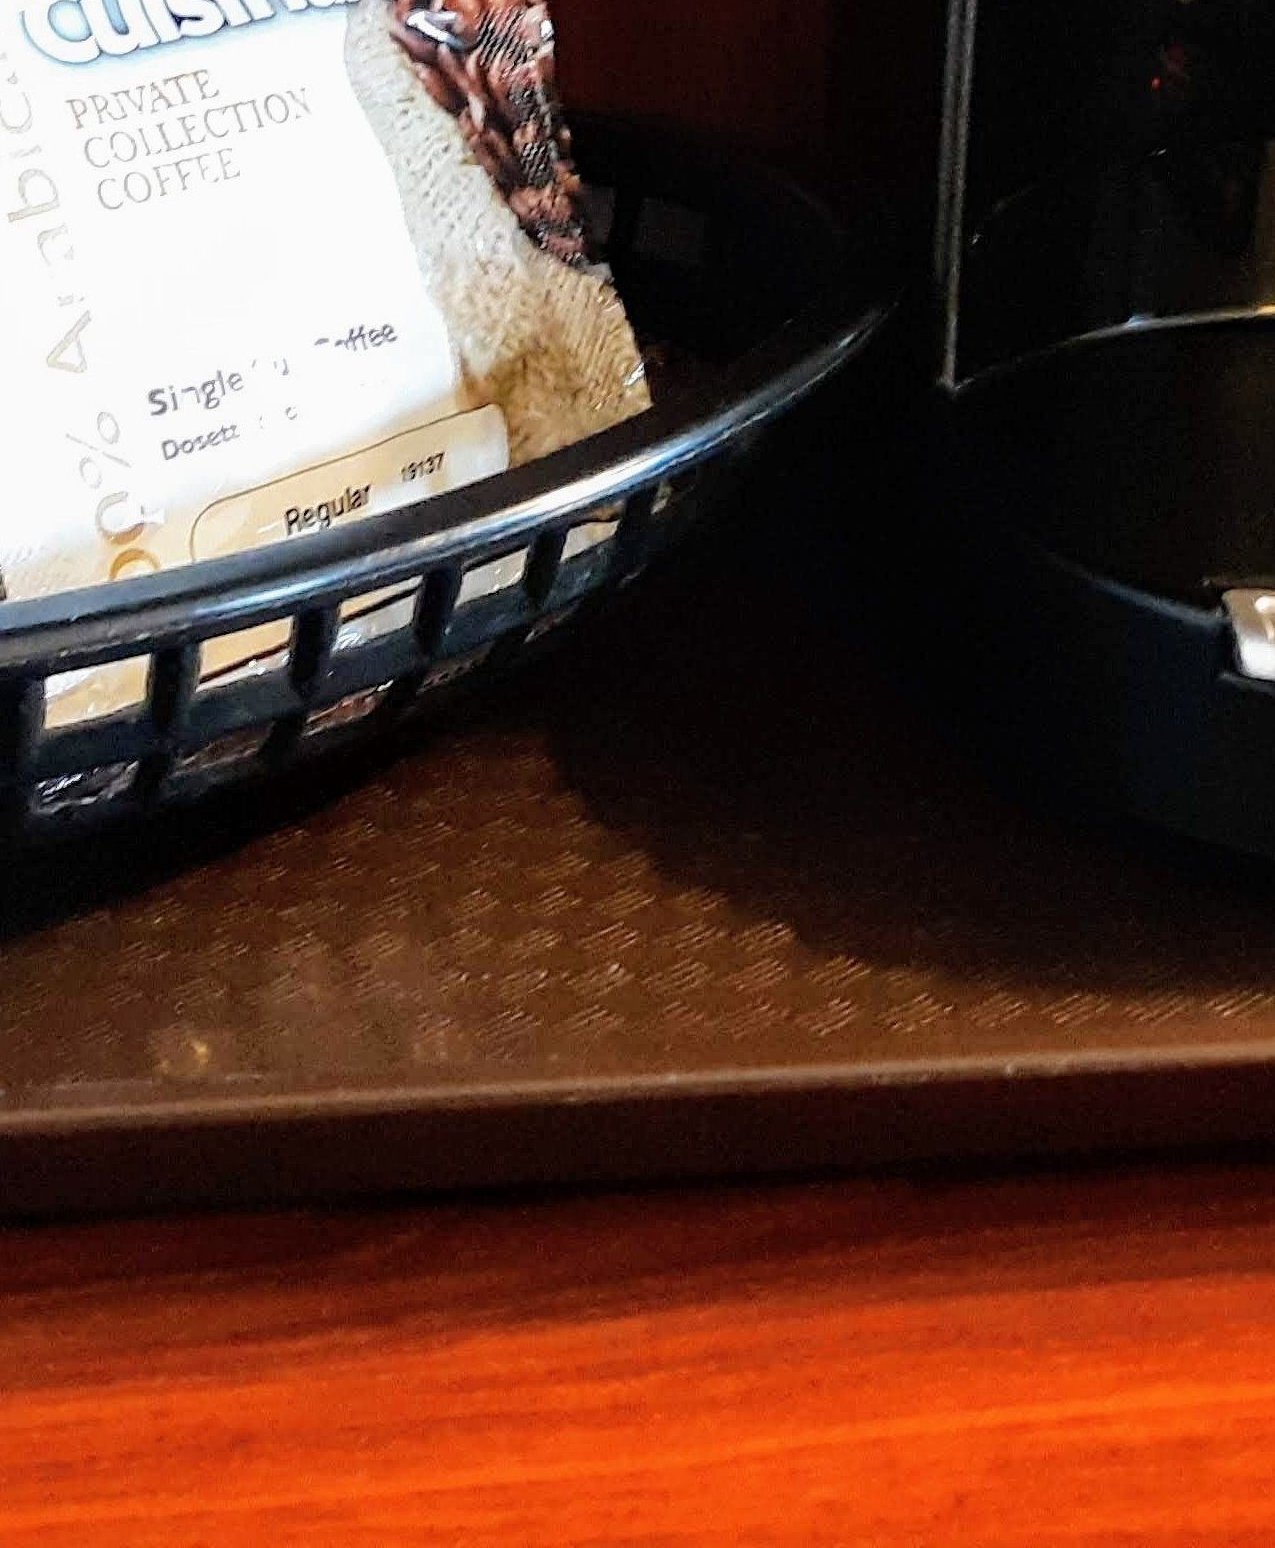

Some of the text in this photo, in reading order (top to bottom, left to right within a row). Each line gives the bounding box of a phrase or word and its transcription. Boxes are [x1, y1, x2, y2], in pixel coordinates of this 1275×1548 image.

[65, 68, 221, 131] PRIVATE
[83, 86, 313, 169] COLLECTION
[96, 147, 241, 210] COFFEE
[148, 368, 245, 417] Single
[284, 482, 372, 536] Regular
